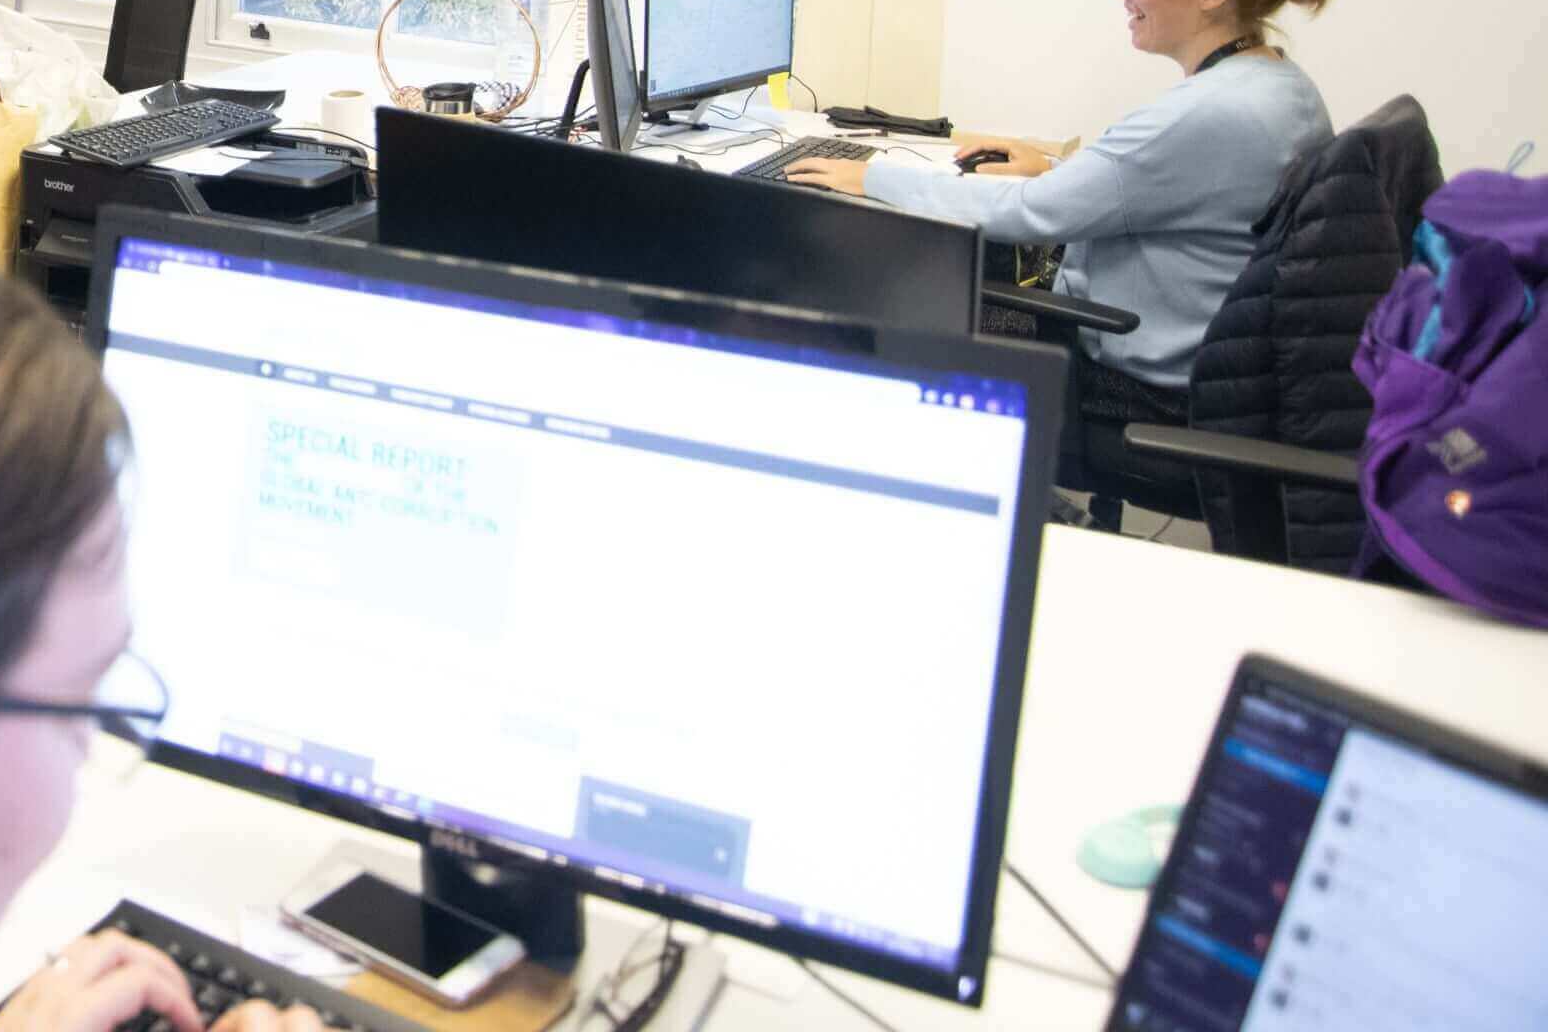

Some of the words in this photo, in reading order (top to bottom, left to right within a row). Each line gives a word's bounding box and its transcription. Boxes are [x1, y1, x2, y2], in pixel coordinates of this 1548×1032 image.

[44, 178, 75, 192] brother
[267, 419, 360, 462] SPECIAL
[371, 441, 466, 476] REPORT
